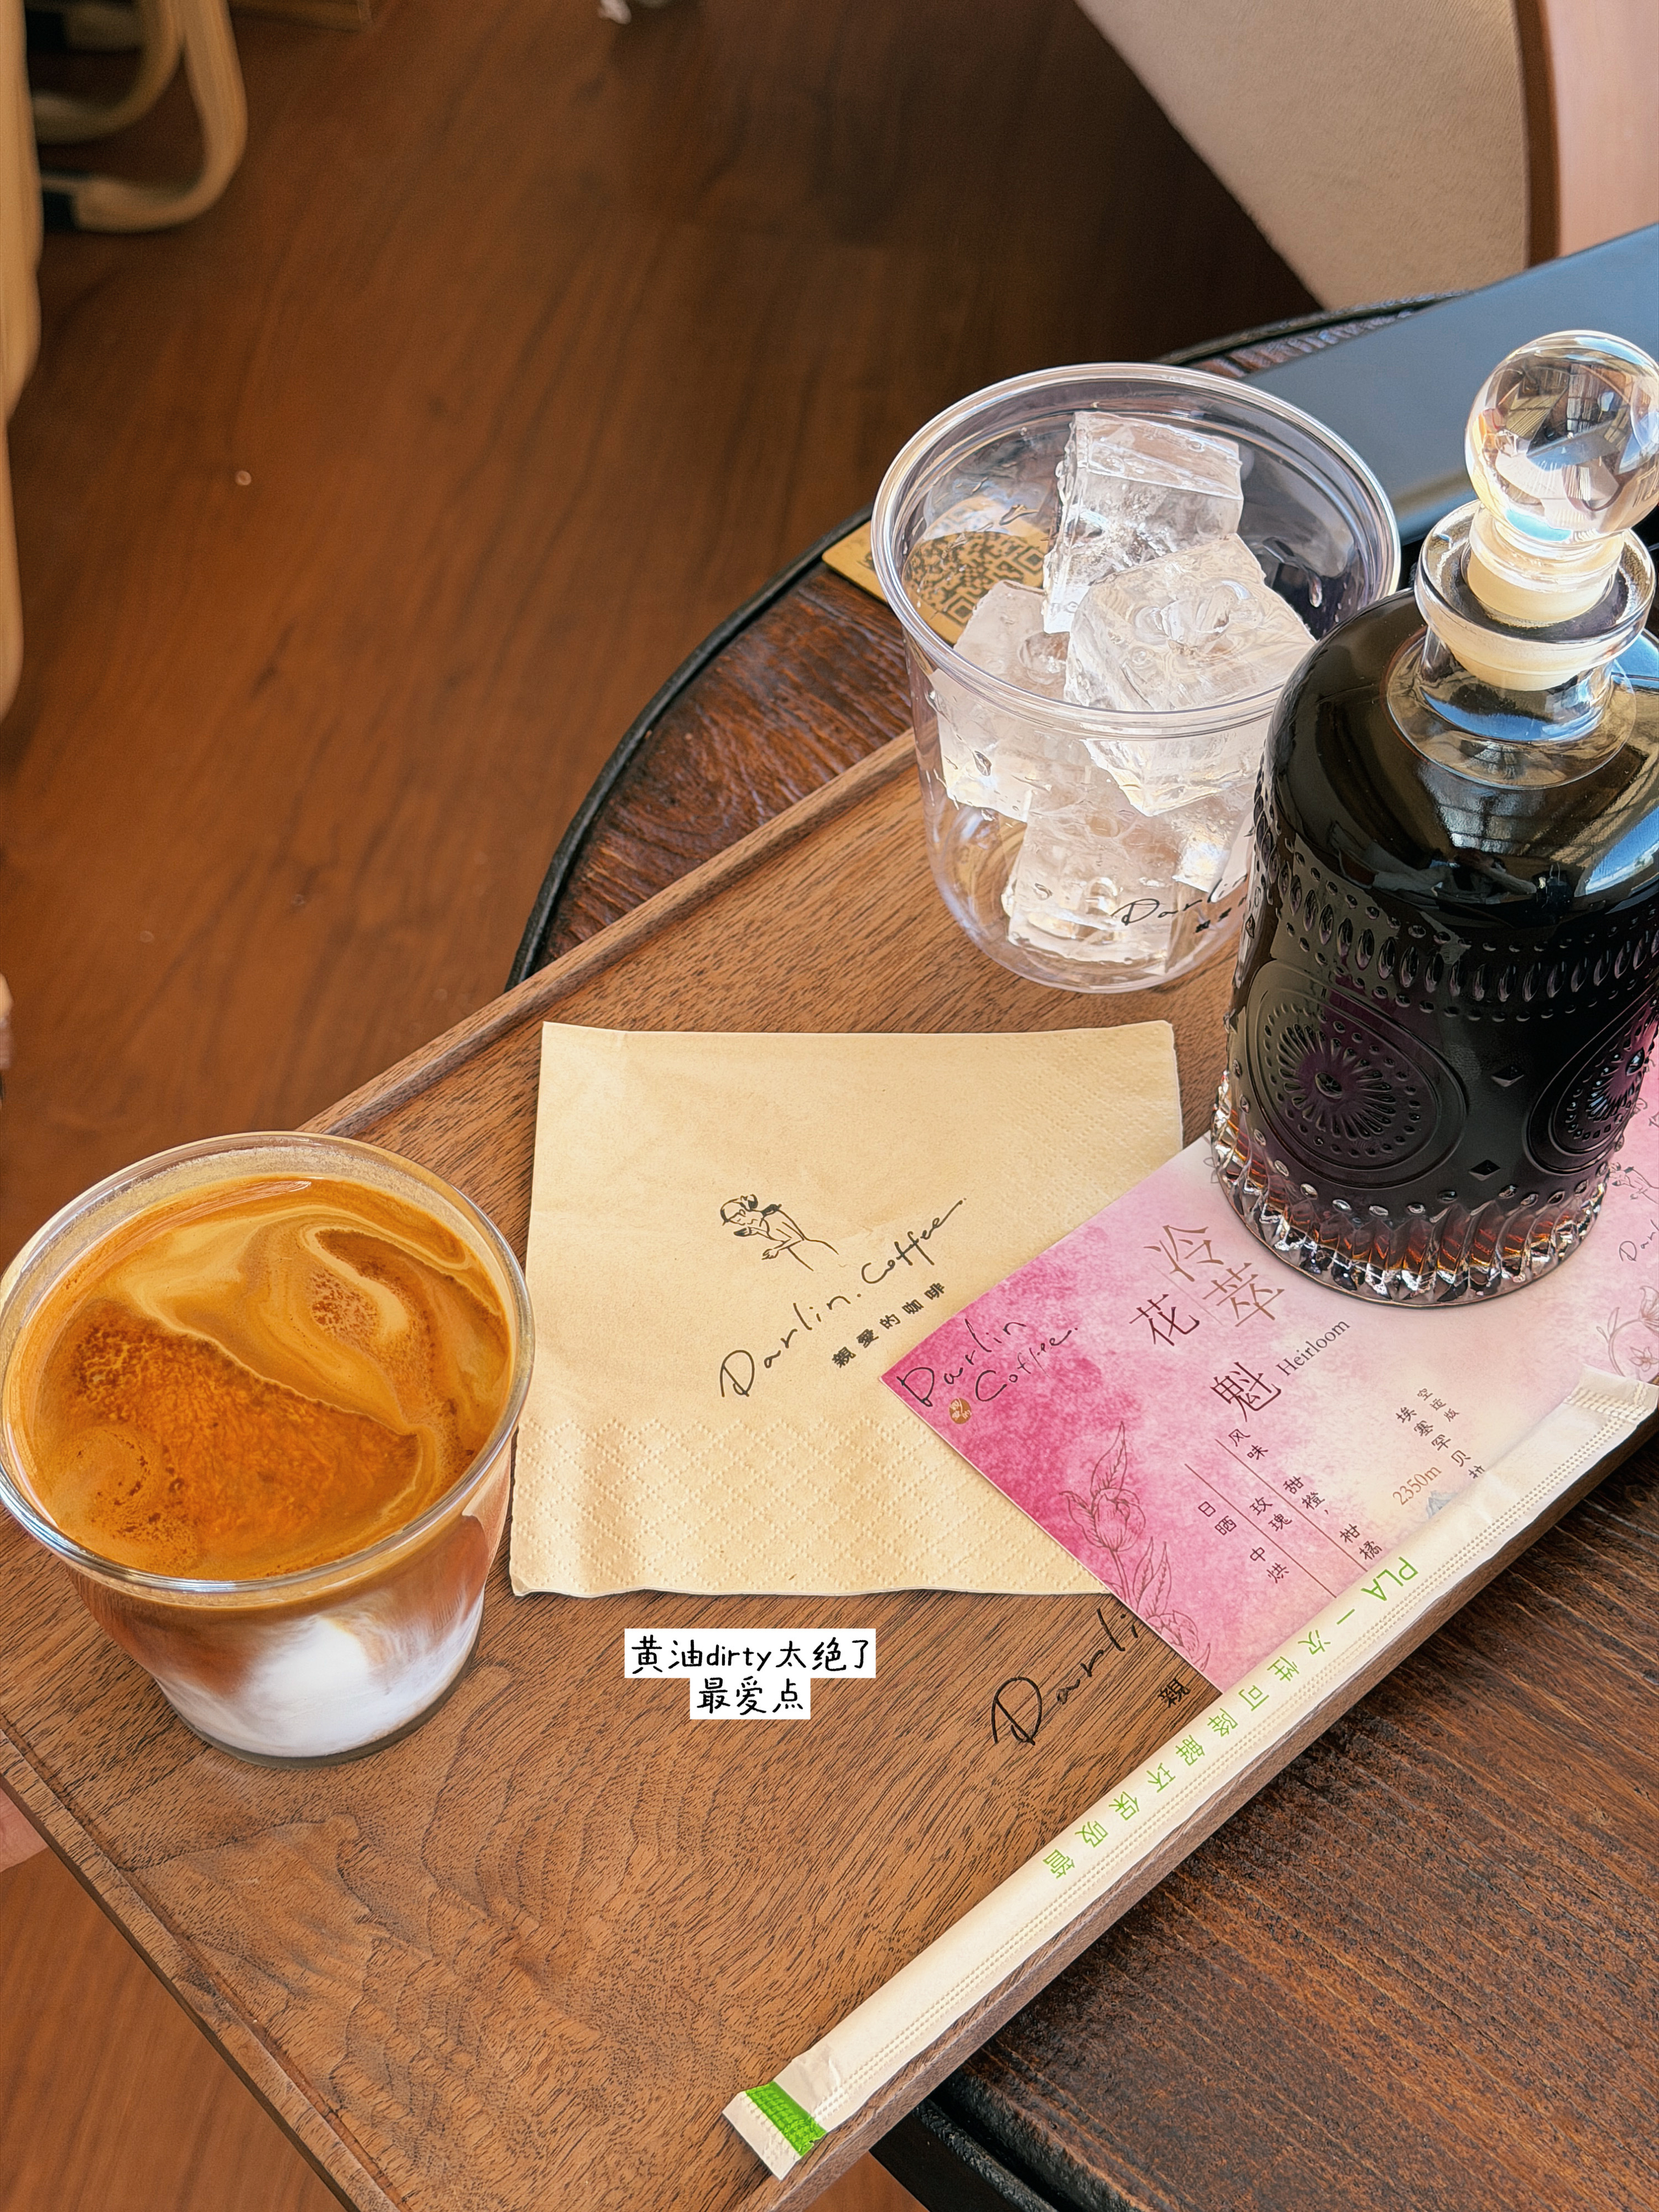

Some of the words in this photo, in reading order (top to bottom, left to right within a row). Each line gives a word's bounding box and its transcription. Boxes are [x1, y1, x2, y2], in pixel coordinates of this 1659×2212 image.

[1143, 1224, 1286, 1328] 冷萃
[896, 1318, 1027, 1407] Darlin
[1128, 1293, 1282, 1423] 花魁
[1275, 1320, 1351, 1377] Heirloom
[1416, 1387, 1460, 1422] 空运版
[1228, 1428, 1269, 1461] 风味
[1392, 1466, 1442, 1506] 2350m
[1249, 1496, 1293, 1532] 玫瑰
